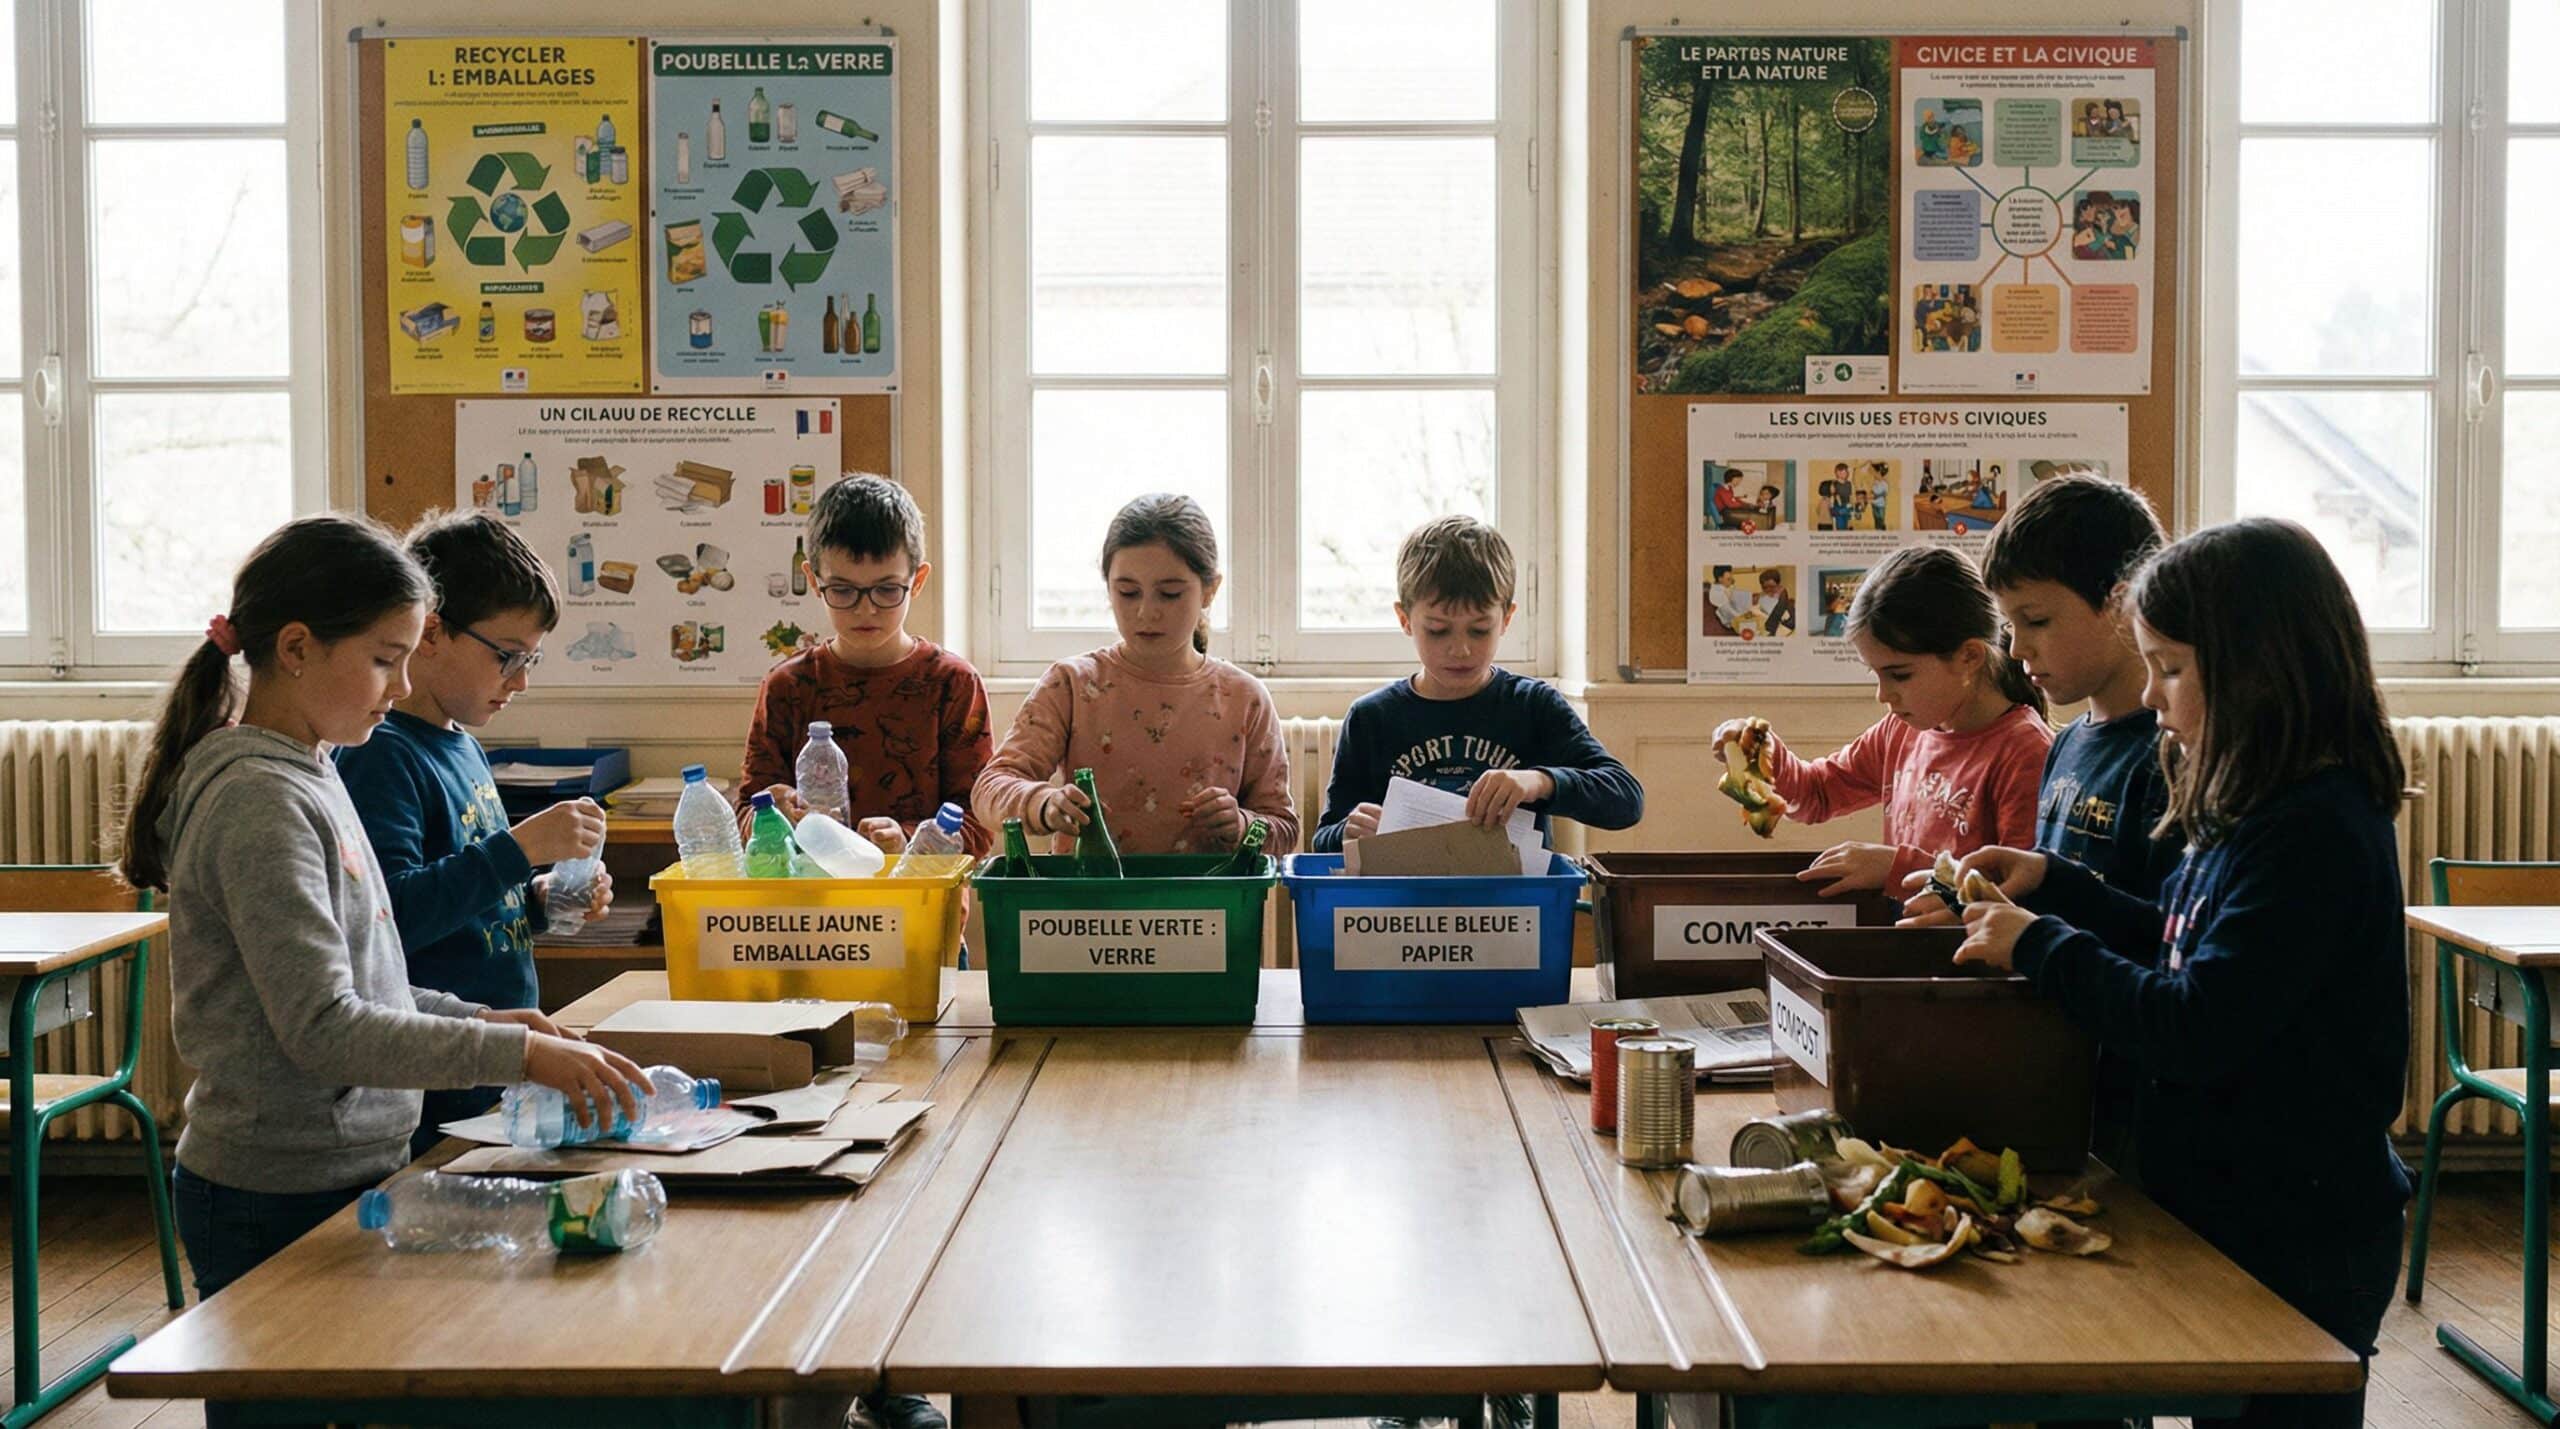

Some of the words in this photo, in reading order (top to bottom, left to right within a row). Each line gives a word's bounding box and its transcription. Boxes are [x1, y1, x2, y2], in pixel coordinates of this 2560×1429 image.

[455, 47, 566, 64] RECYCLER
[661, 53, 781, 70] POUBELLLE
[815, 53, 885, 70] VERRE
[1681, 47, 1701, 61] LE
[1777, 47, 1848, 61] NATURE
[1917, 47, 1987, 63] CIVICE
[1993, 47, 2017, 62] ET
[2023, 47, 2049, 62] LA
[2053, 47, 2138, 66] CIVIQUE
[453, 69, 596, 86] EMBALLAGES
[1702, 66, 1723, 80] ET
[1728, 66, 1750, 80] LA
[1756, 66, 1828, 80] NATURE
[540, 407, 566, 421] UN
[571, 407, 636, 421] CILAUU
[640, 407, 662, 421] DE
[668, 407, 756, 421] RECYCLLE
[1769, 412, 1799, 425] LES
[1804, 412, 1855, 425] CIVIIS
[1861, 412, 1893, 425] UES
[1965, 412, 2047, 427] CIVIQUES
[706, 915, 811, 932] POUBELLE
[816, 915, 883, 932] JAUNE
[891, 919, 896, 931] :
[1028, 919, 1133, 936] POUBELLE
[1139, 919, 1204, 936] VERTE
[1211, 923, 1216, 935] :
[1343, 916, 1448, 933] POUBELLE
[1455, 916, 1519, 932] BLEUE
[1526, 920, 1531, 932] :
[733, 943, 870, 961] EMBALLAGES
[1089, 948, 1156, 965] VERRE
[1402, 945, 1474, 962] PAPIER
[1776, 1001, 1818, 1059] COMPOST
